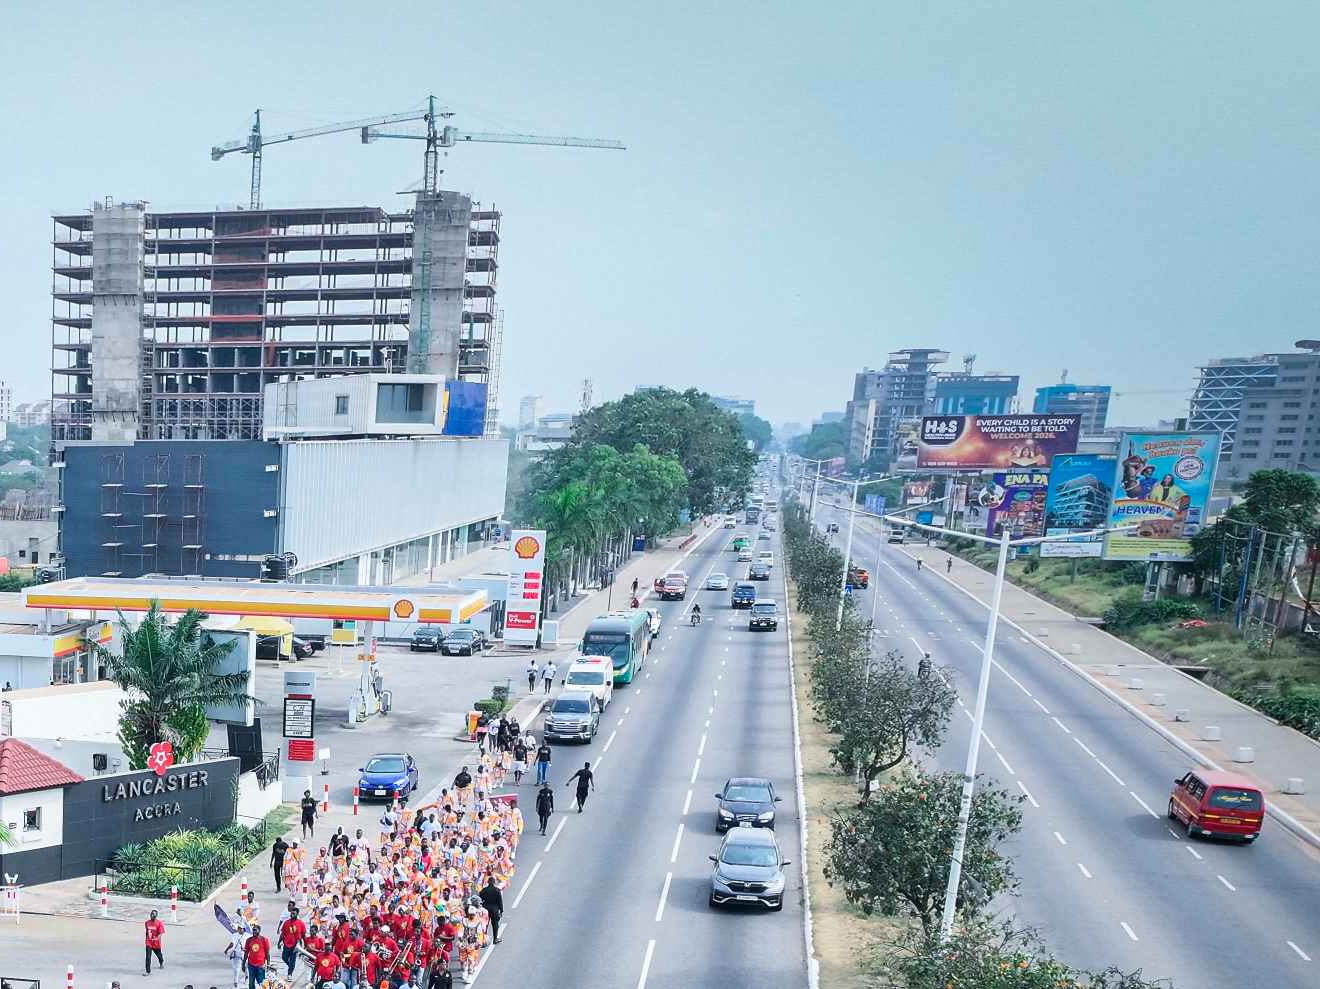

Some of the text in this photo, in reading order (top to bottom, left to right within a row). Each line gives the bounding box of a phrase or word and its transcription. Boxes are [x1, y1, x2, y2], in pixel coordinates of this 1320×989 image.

[1005, 474, 1029, 486] ENA
[102, 770, 209, 802] LANCASTER
[134, 801, 182, 822] ACCRA
